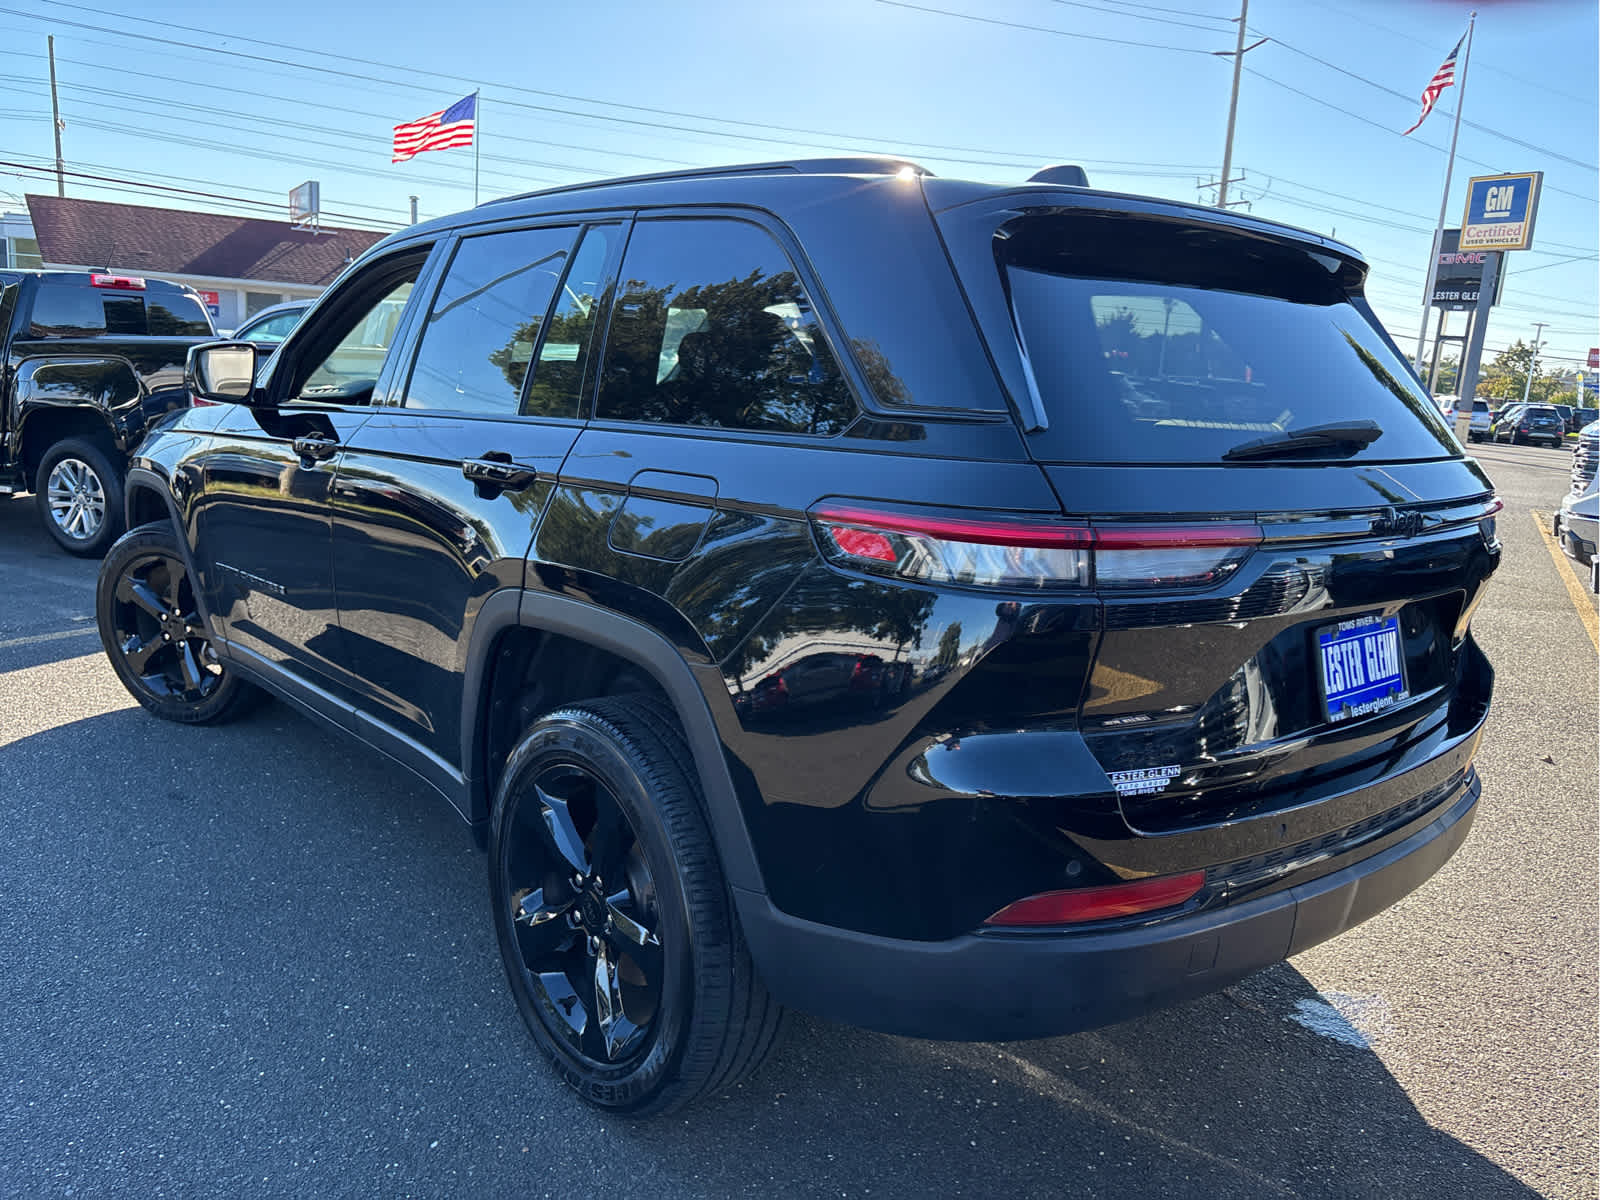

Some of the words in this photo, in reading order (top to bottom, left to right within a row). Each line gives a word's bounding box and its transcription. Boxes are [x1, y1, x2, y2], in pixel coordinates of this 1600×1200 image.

[1485, 186, 1514, 212] GM
[1466, 224, 1522, 238] Certified
[1438, 252, 1488, 265] GMC
[1338, 620, 1355, 631] TOMS
[1322, 640, 1365, 695] LESTER
[1364, 631, 1399, 682] GLENN
[1111, 771, 1145, 781] ESTER
[1148, 767, 1181, 778] GLENN
[1120, 788, 1137, 797] TOMS
